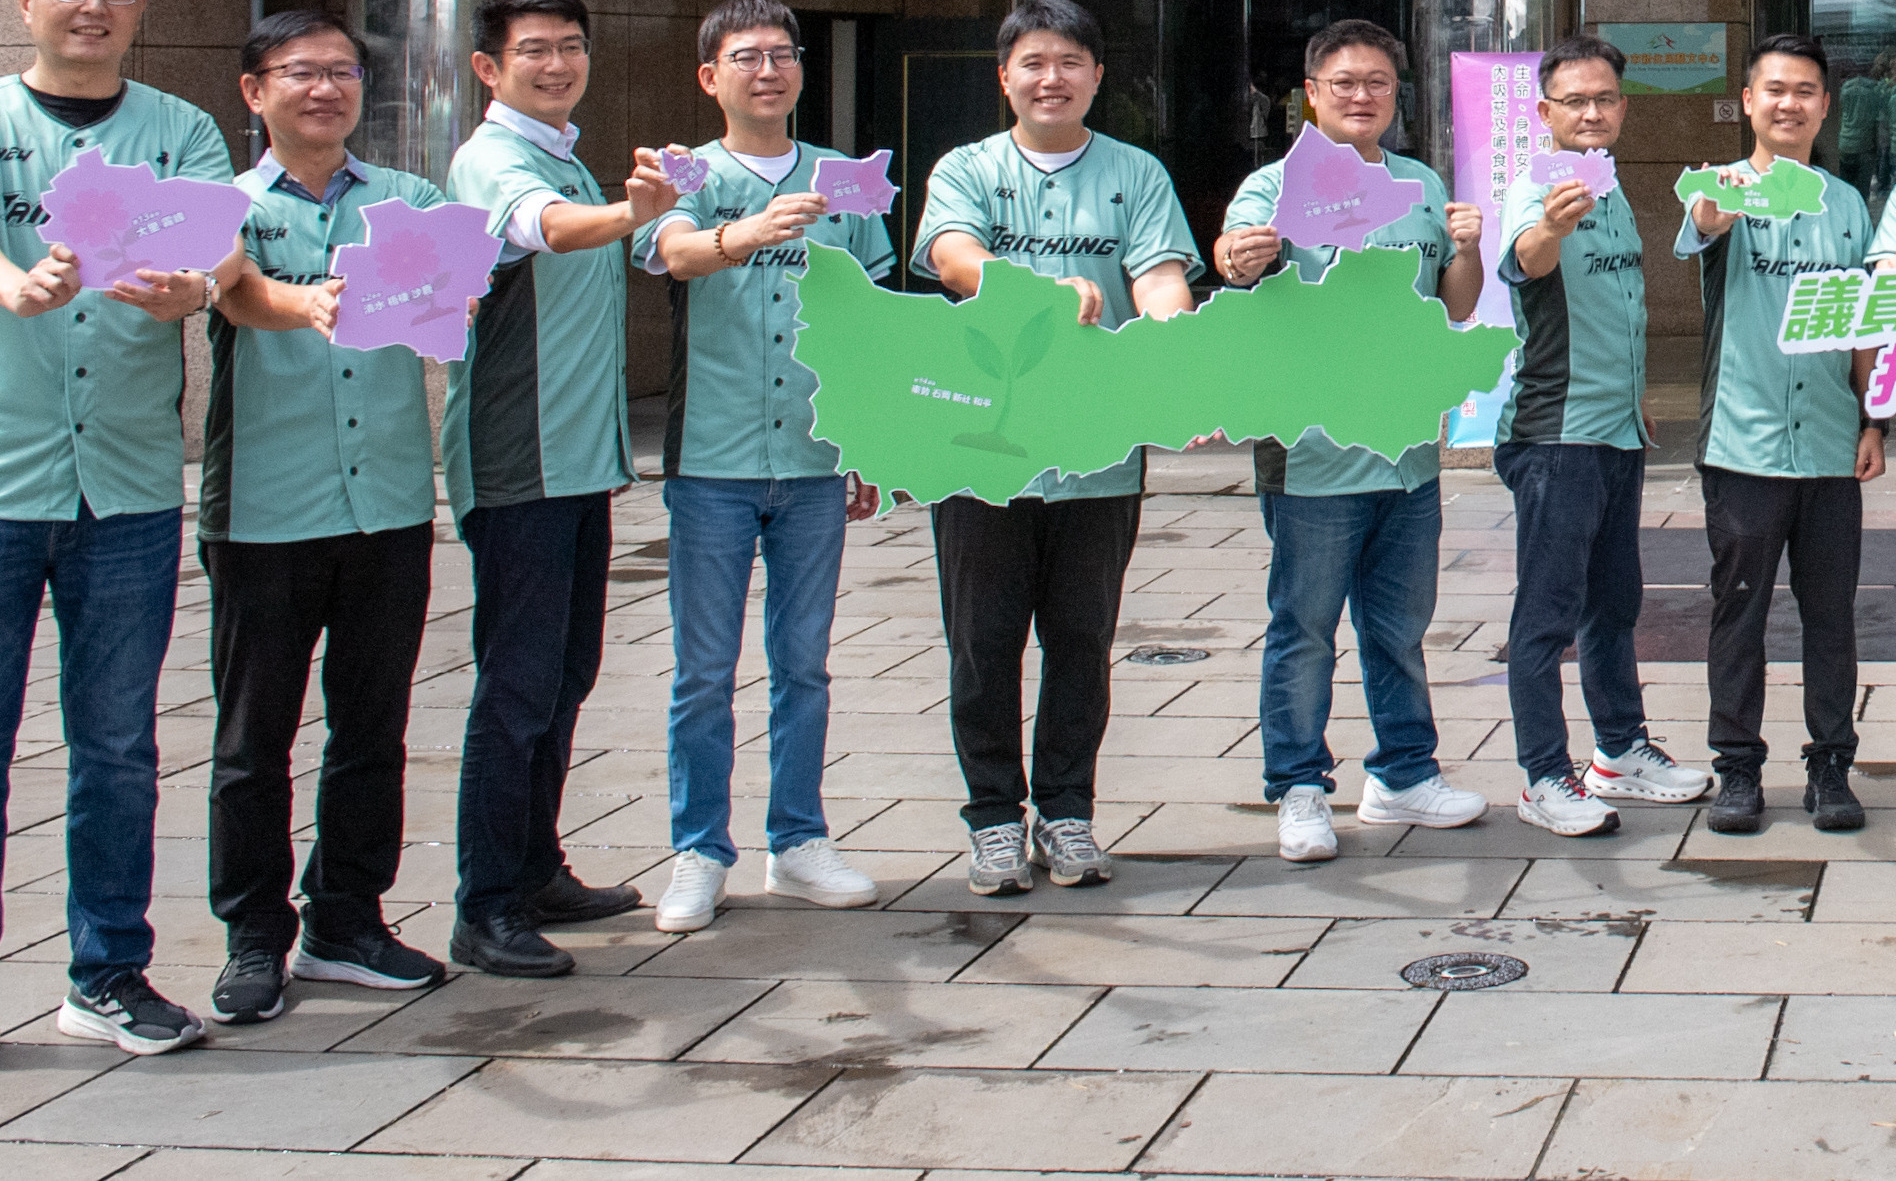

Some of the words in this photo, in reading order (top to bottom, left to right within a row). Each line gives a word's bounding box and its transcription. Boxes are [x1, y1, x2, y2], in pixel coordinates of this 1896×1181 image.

[713, 206, 746, 219] NEW
[1576, 220, 1598, 232] NEW
[989, 224, 1120, 256] TAICHUNG
[1583, 252, 1642, 276] TAICHUN
